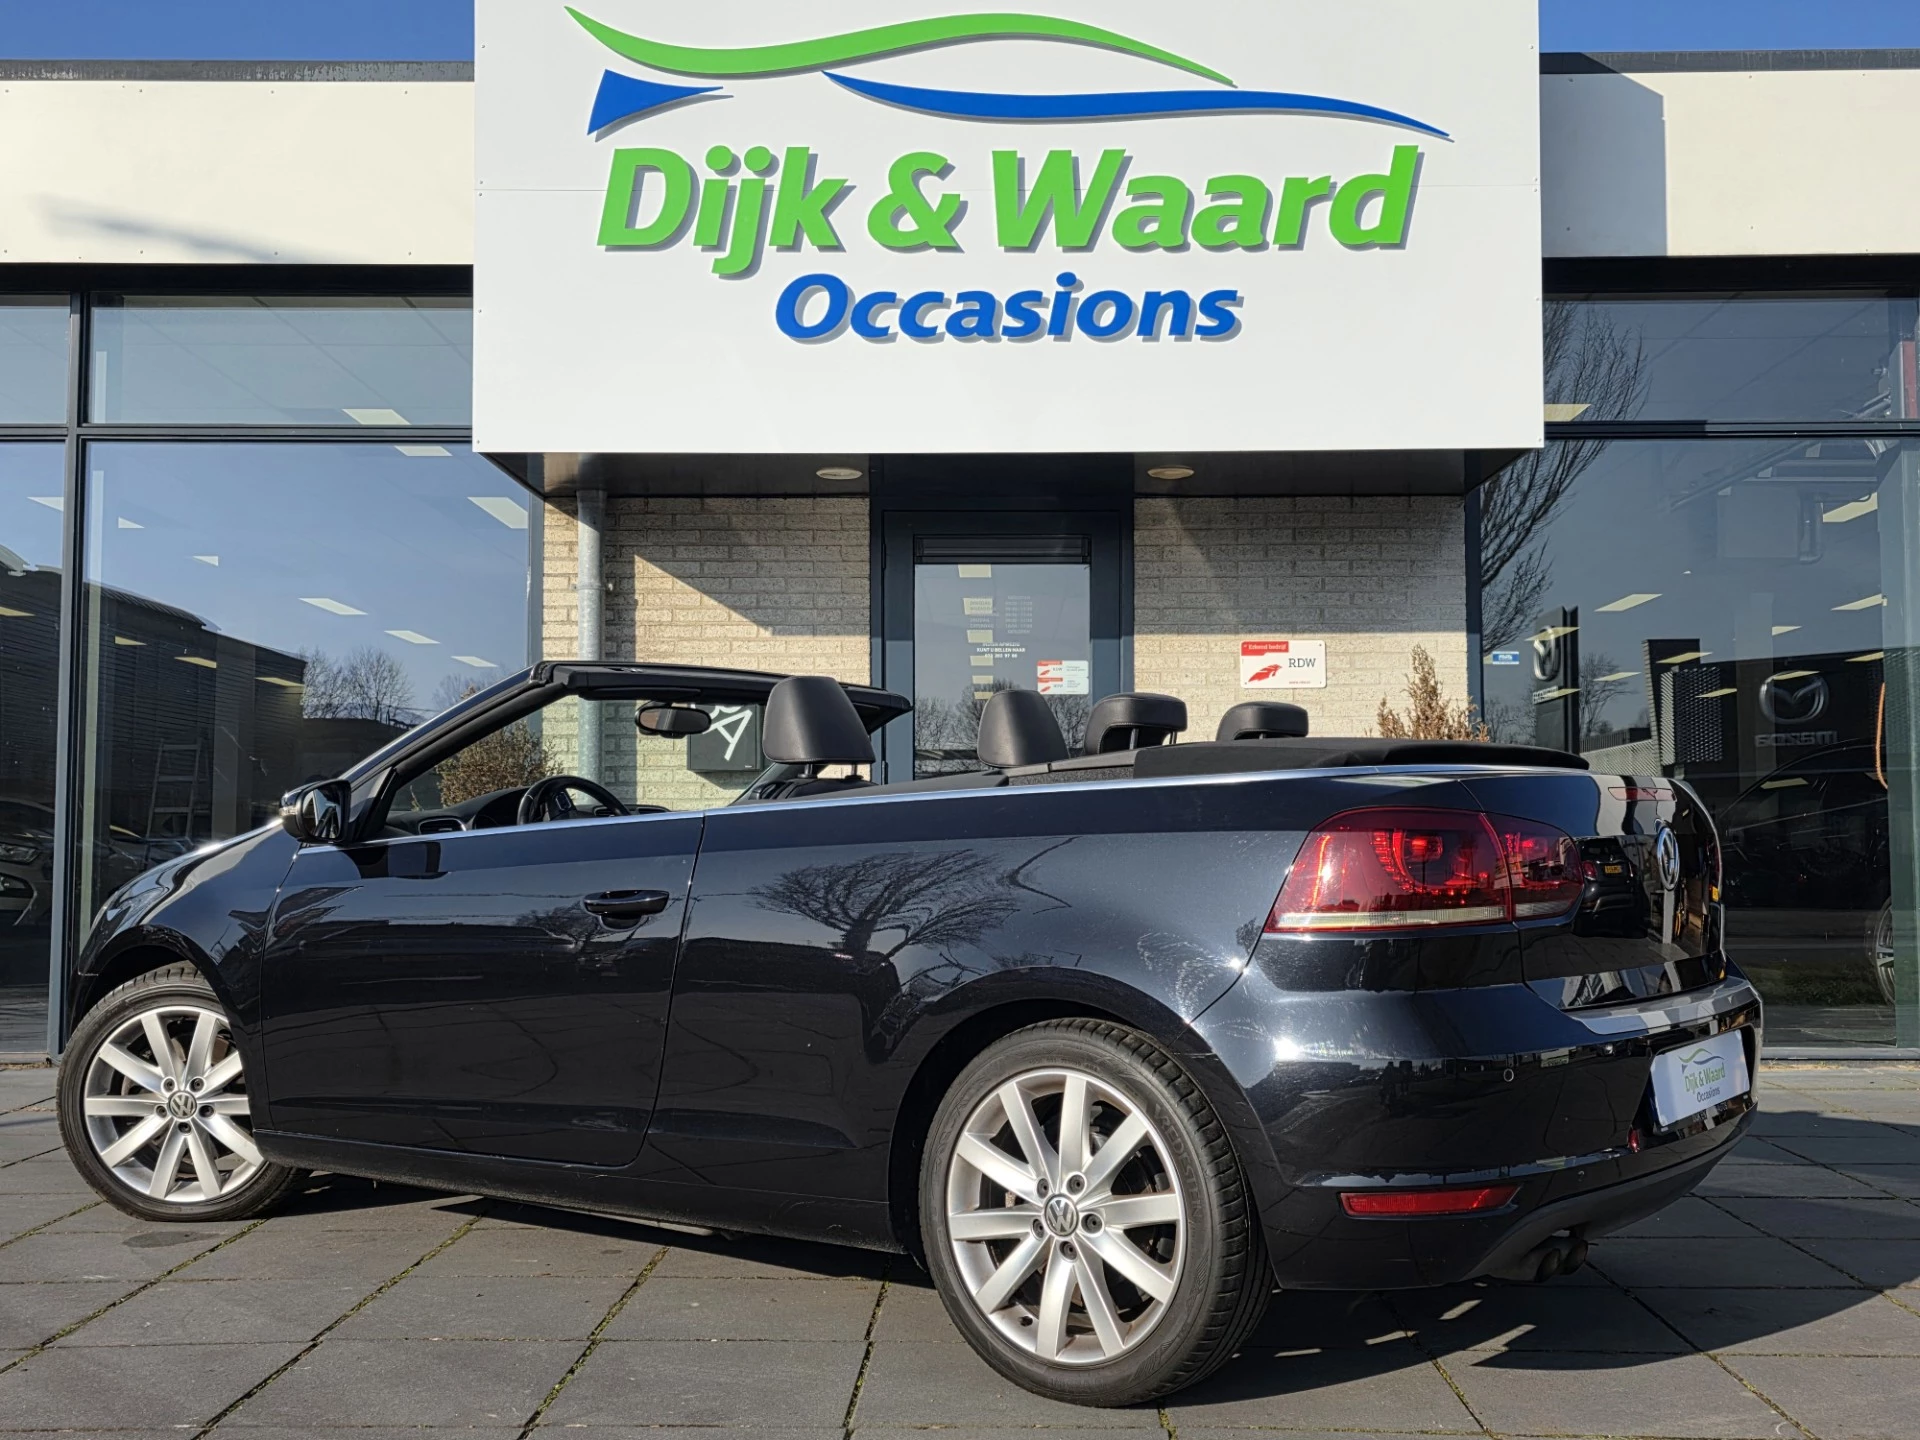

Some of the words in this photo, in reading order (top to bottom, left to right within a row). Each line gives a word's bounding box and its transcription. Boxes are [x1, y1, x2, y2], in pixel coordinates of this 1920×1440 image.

[598, 146, 847, 275] Dijk
[867, 151, 963, 248] &
[992, 145, 1419, 248] Waard
[776, 272, 1238, 339] Occasions
[1288, 658, 1316, 668] RDW
[1684, 1071, 1699, 1094] Dijk
[1703, 1062, 1726, 1084] Waard
[1696, 1086, 1721, 1103] Occasions
